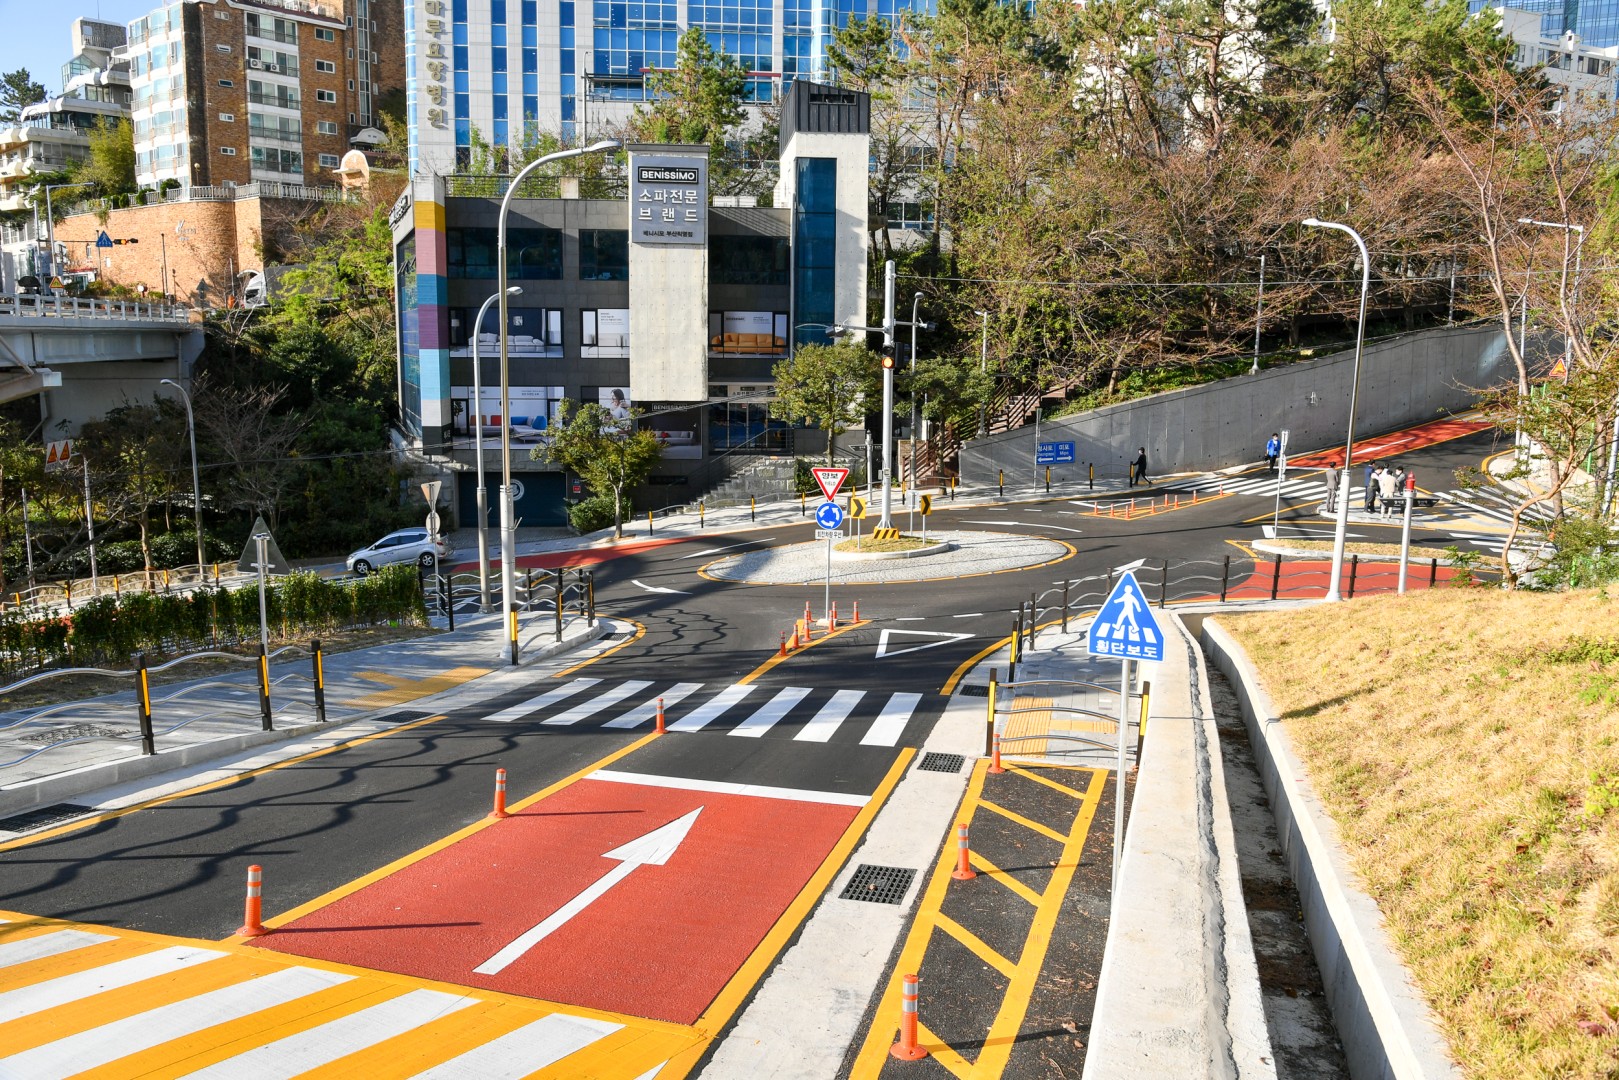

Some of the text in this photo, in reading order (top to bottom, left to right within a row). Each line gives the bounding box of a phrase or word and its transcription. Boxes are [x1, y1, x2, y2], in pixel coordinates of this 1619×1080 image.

[641, 168, 695, 180] BENISSIMO
[638, 189, 698, 204] 소파전문
[638, 207, 698, 222] 브랜드
[821, 472, 839, 480] 양보
[1096, 639, 1158, 659] 횡단보도
